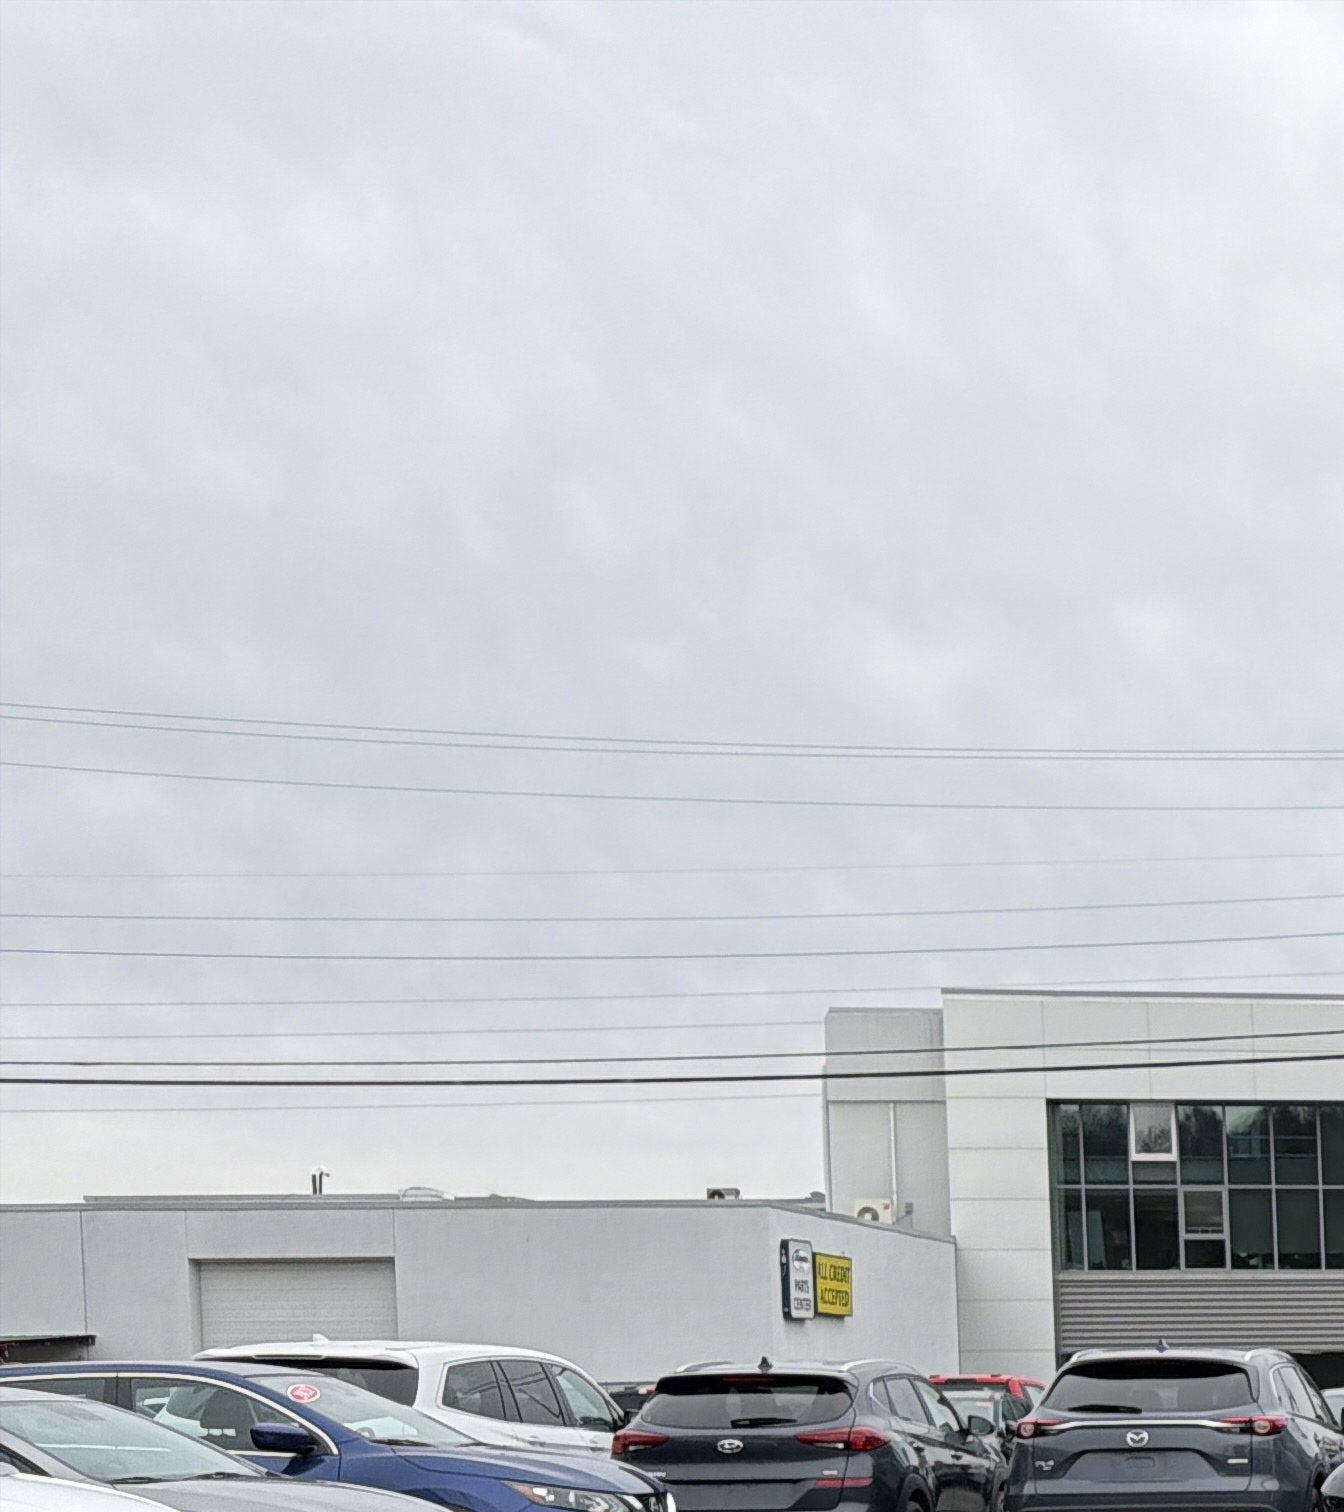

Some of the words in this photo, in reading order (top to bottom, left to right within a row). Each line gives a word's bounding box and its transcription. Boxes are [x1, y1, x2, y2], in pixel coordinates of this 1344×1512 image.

[817, 1262, 828, 1281] ALL
[829, 1263, 850, 1284] CREDIT
[793, 1297, 812, 1312] CENTER
[820, 1287, 850, 1308] ACCEPTED
